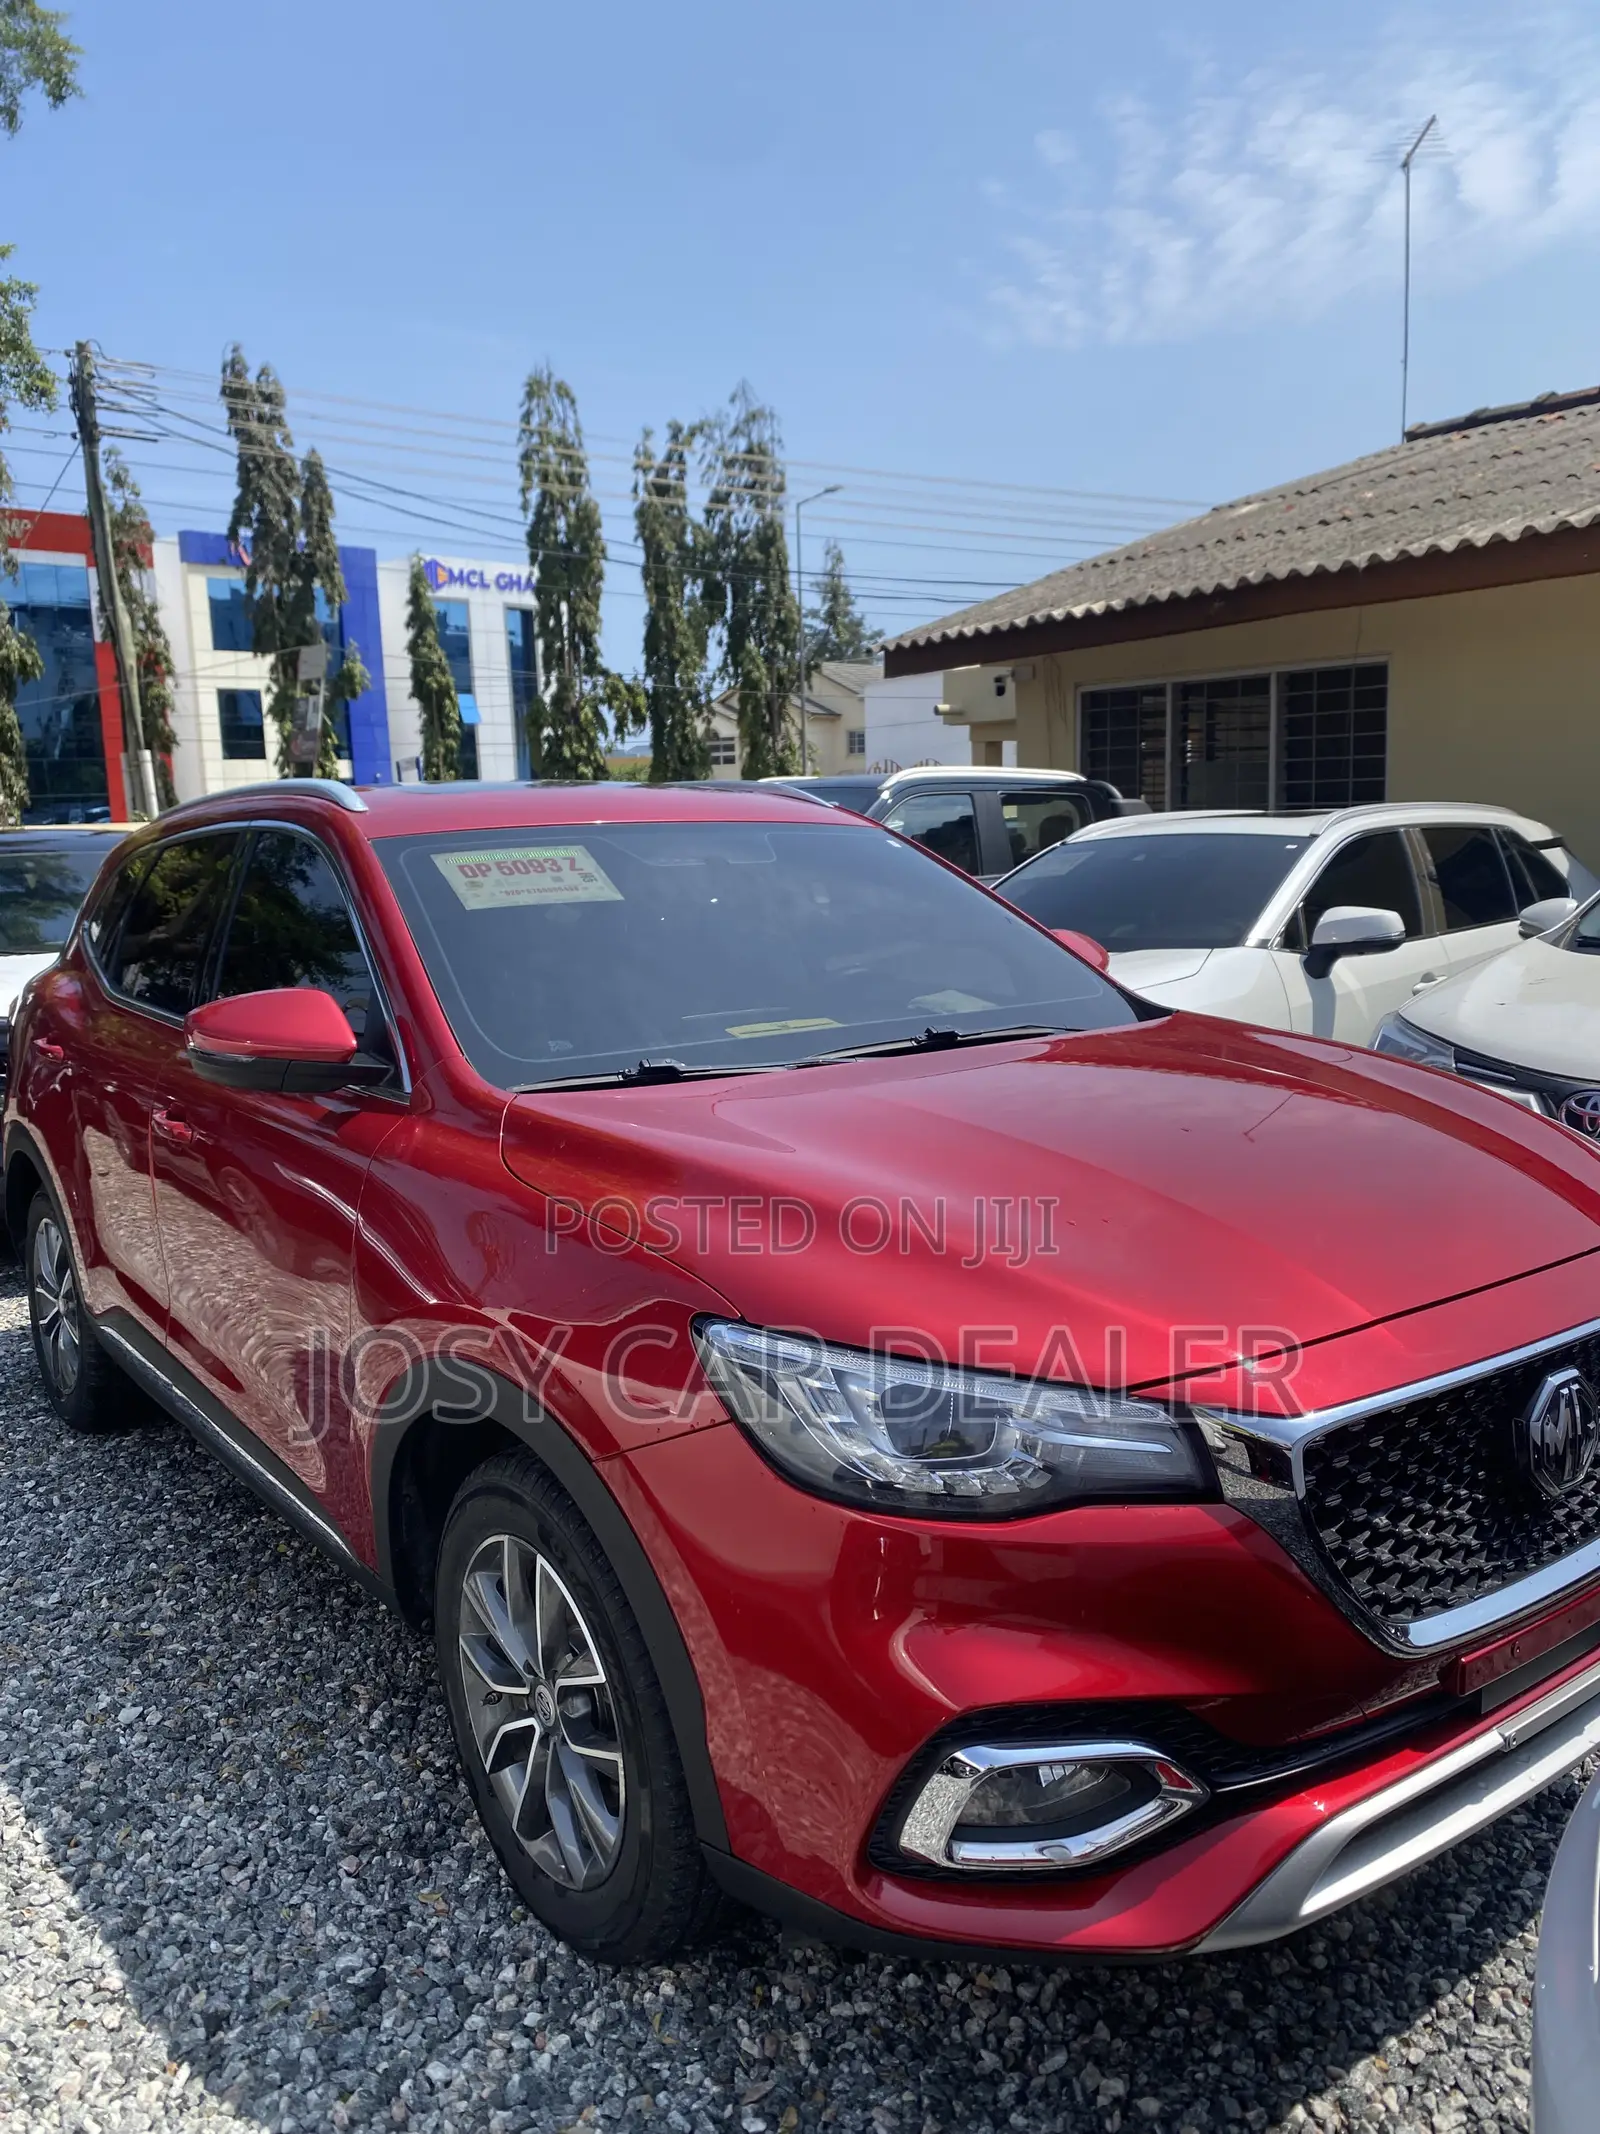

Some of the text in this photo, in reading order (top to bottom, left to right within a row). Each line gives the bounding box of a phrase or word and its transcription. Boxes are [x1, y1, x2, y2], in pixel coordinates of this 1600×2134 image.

[447, 567, 490, 589] MCL
[456, 862, 492, 879] DP
[494, 858, 563, 876] 5093
